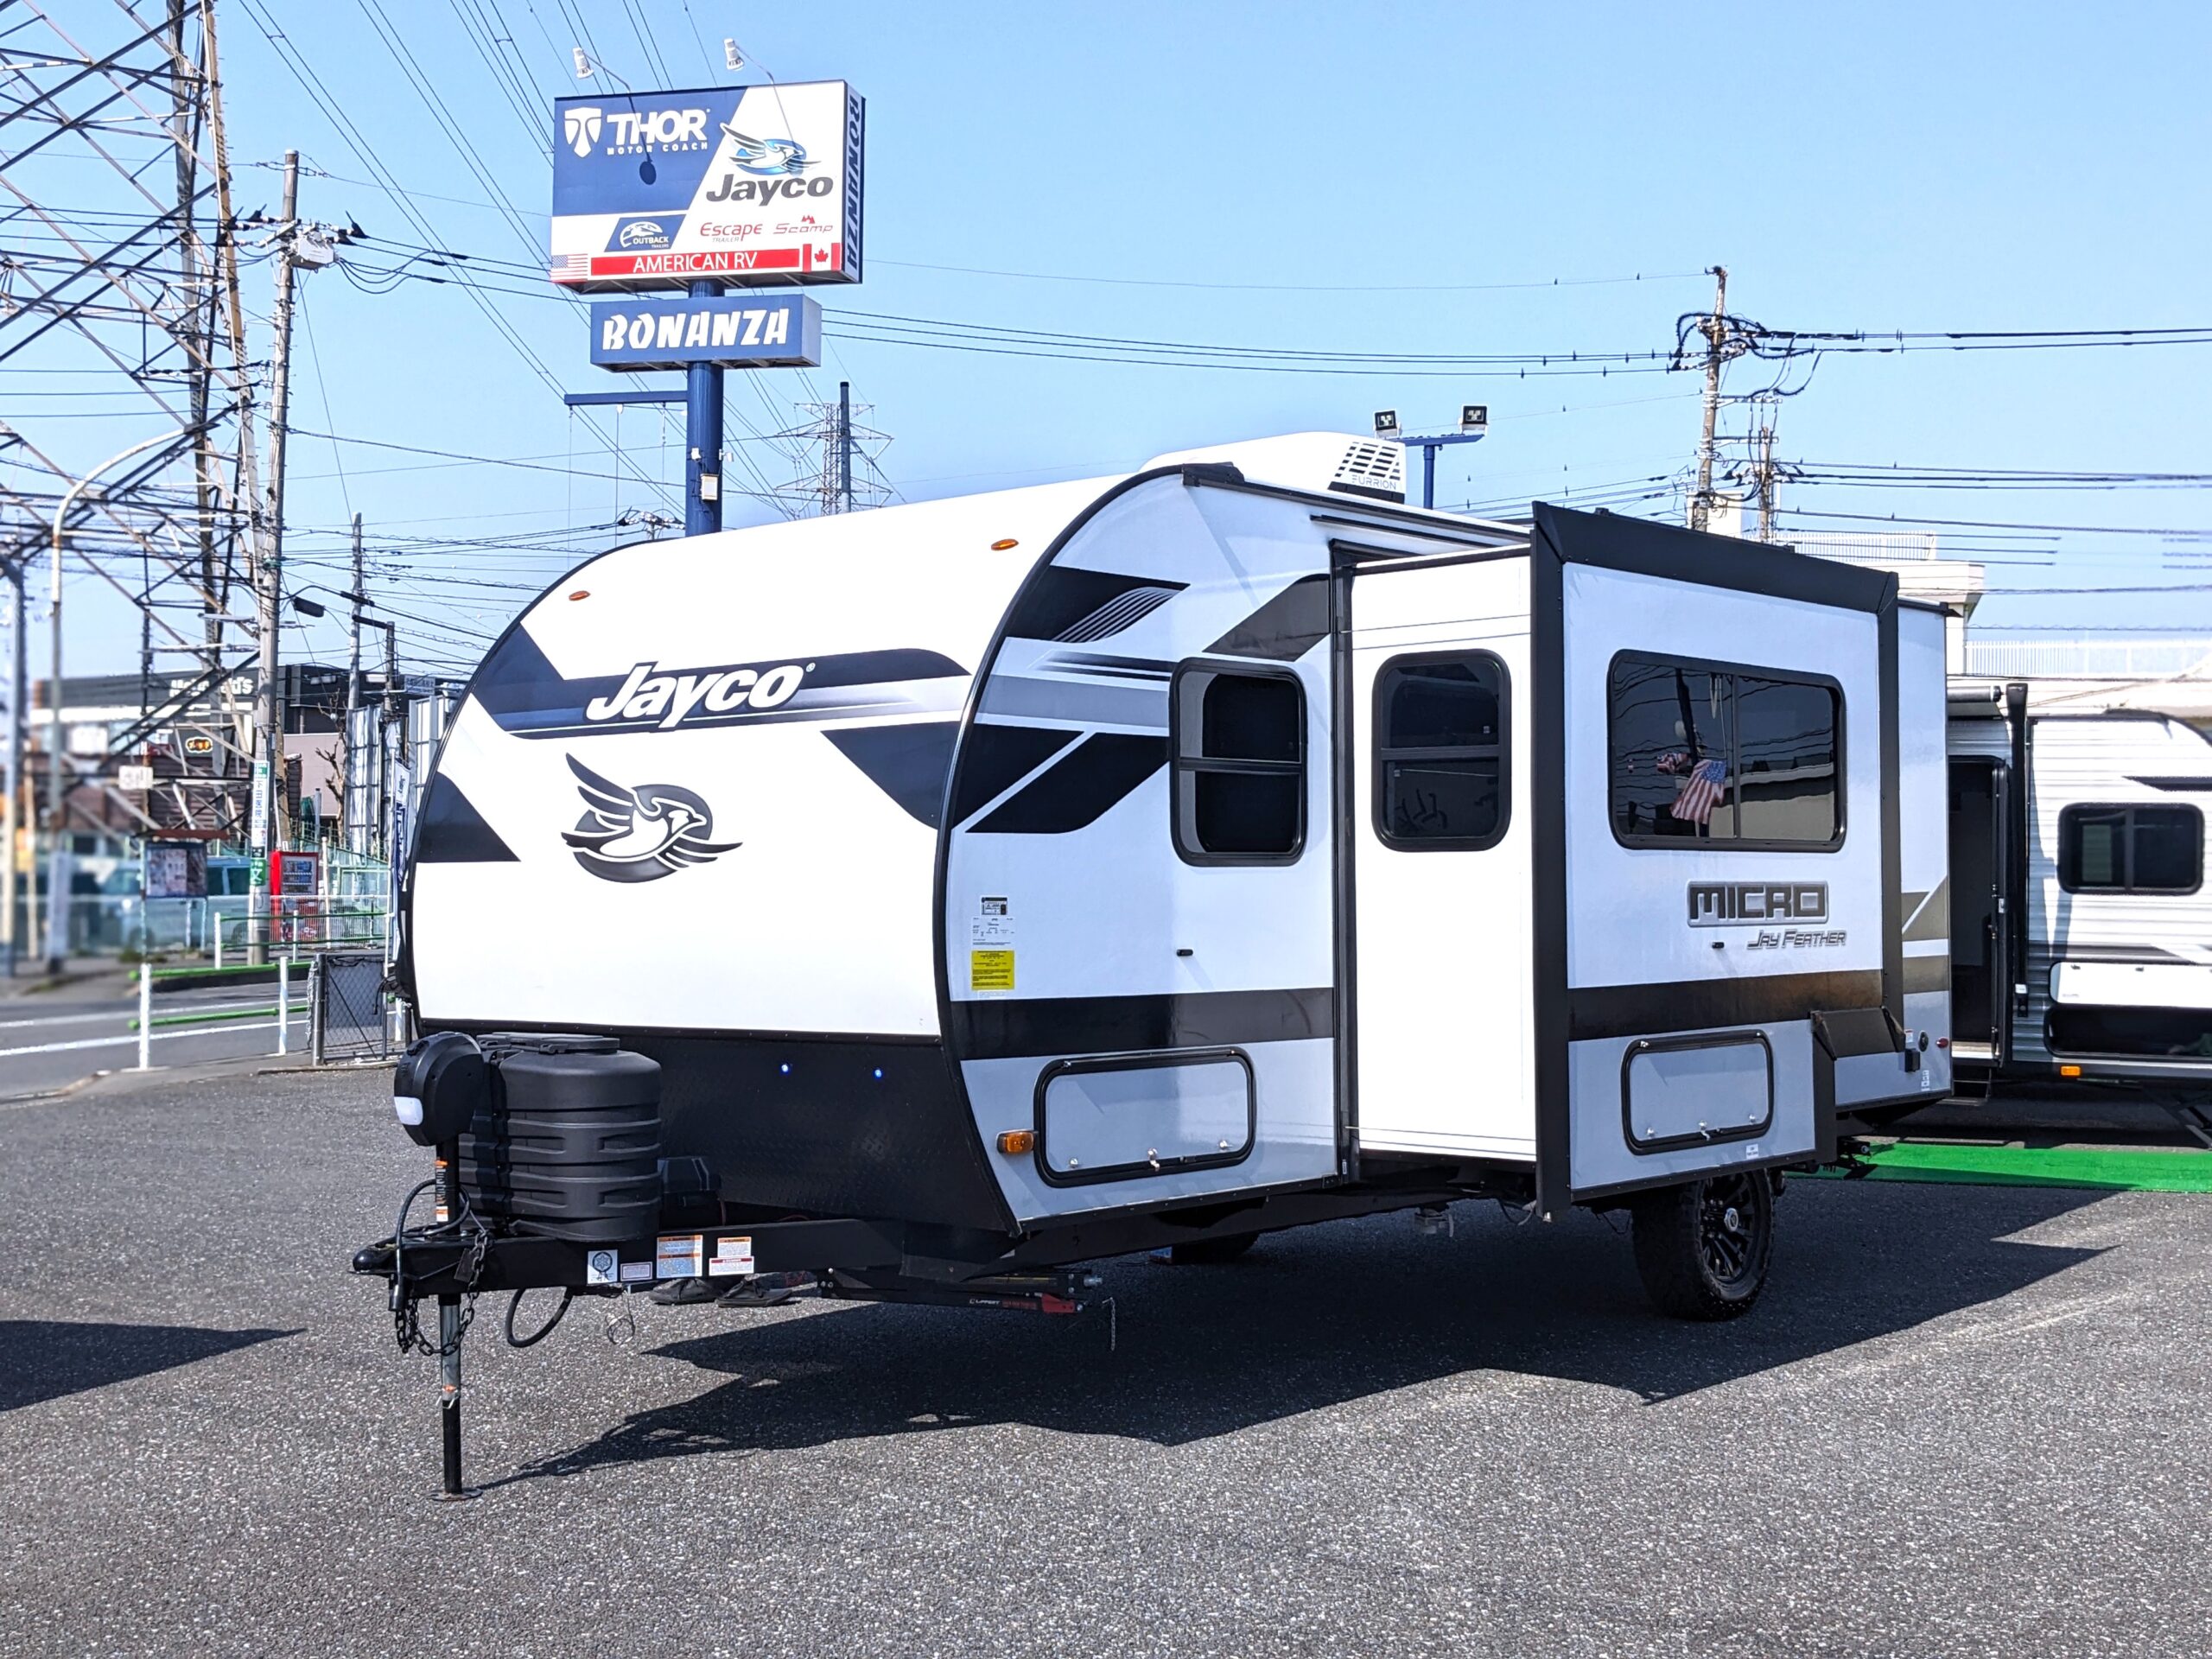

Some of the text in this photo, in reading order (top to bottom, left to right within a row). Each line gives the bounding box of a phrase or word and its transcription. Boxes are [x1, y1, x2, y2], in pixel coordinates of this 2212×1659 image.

[607, 109, 708, 145] THOR
[607, 142, 708, 155] MOTOR COACH
[706, 174, 834, 207] Jayco
[847, 94, 860, 270] BONANZA
[632, 236, 670, 245] OUTBACK
[700, 222, 763, 241] Escape
[632, 251, 758, 273] AMERICAN RV
[602, 308, 790, 350] BONANZA
[587, 663, 804, 728] Jayco
[1688, 883, 1827, 924] MICRO
